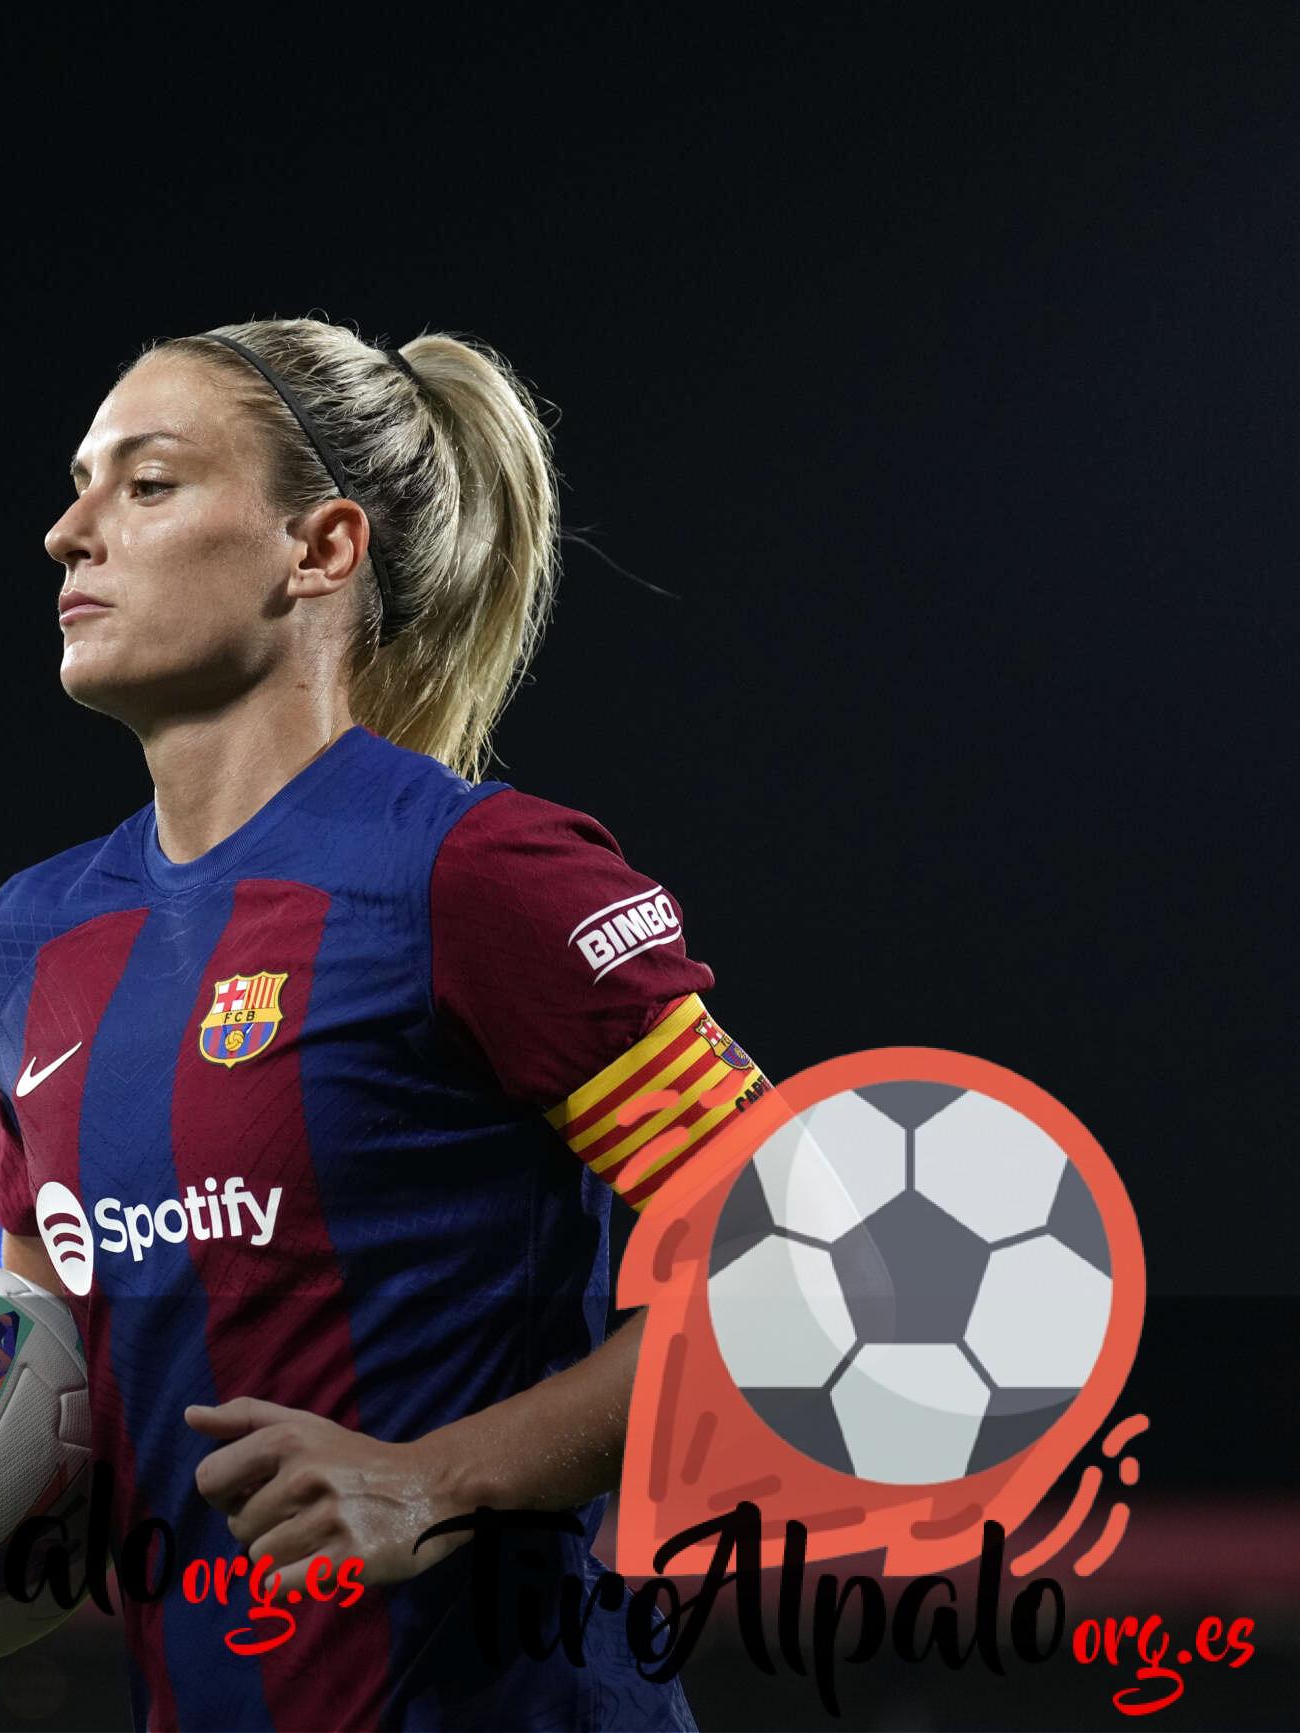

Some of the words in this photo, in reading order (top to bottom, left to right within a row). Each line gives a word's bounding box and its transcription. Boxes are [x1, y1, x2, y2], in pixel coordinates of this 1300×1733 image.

[576, 894, 680, 970] BIMBO
[223, 1010, 256, 1024] FCB
[94, 1176, 283, 1262] Spotify
